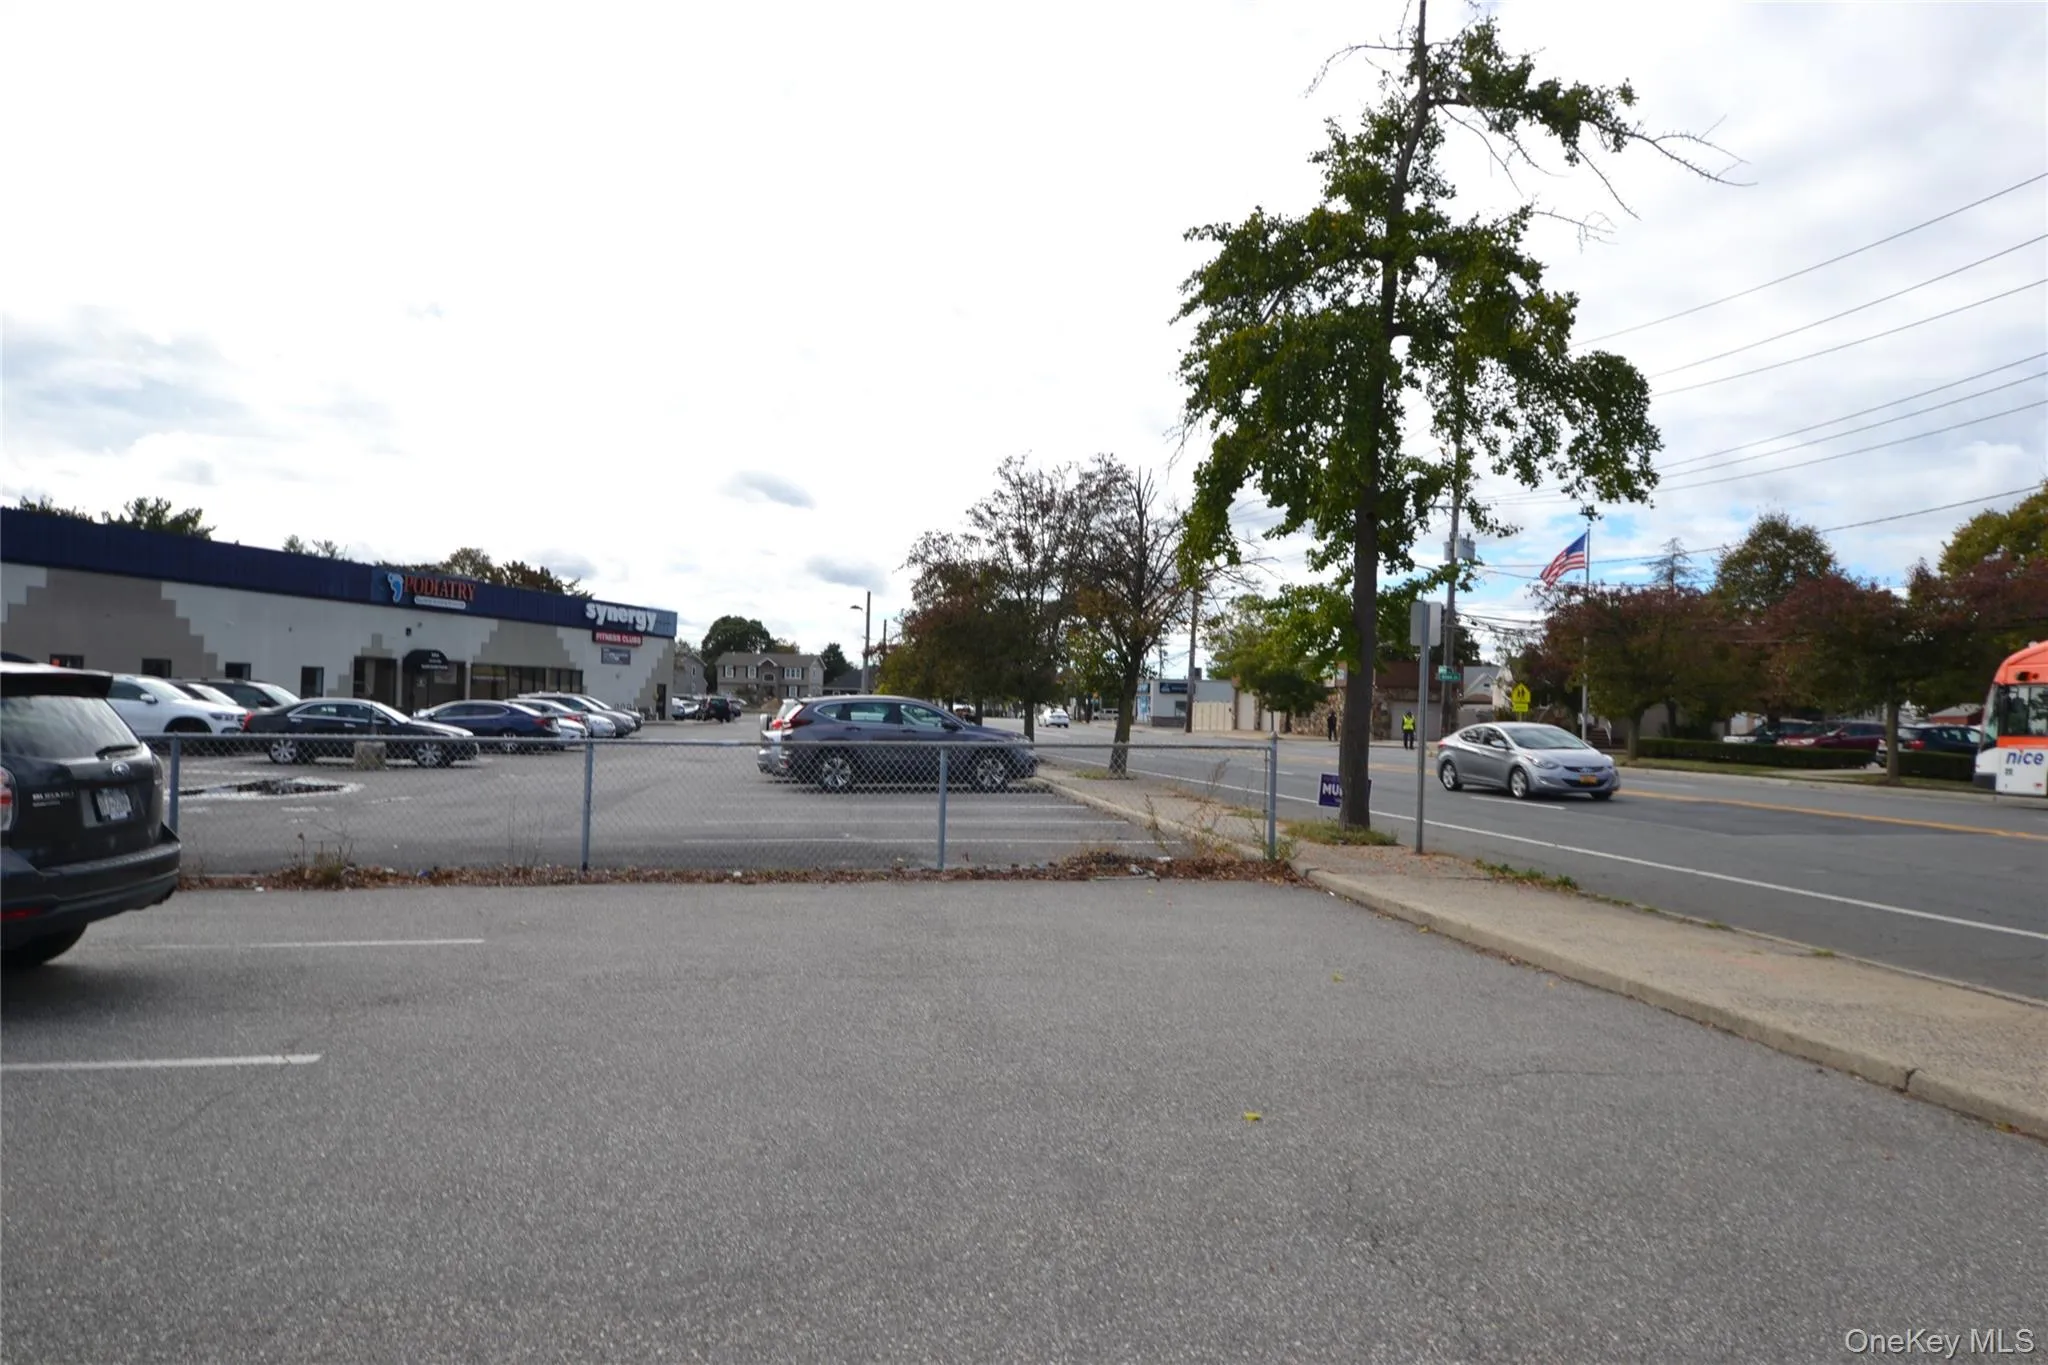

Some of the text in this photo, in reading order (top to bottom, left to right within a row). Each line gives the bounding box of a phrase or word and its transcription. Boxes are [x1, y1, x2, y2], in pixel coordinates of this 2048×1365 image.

[404, 576, 475, 601] PODIATRY
[585, 602, 657, 632] synergy
[596, 632, 641, 645] FITNESS CLUBS
[2006, 752, 2044, 765] nice
